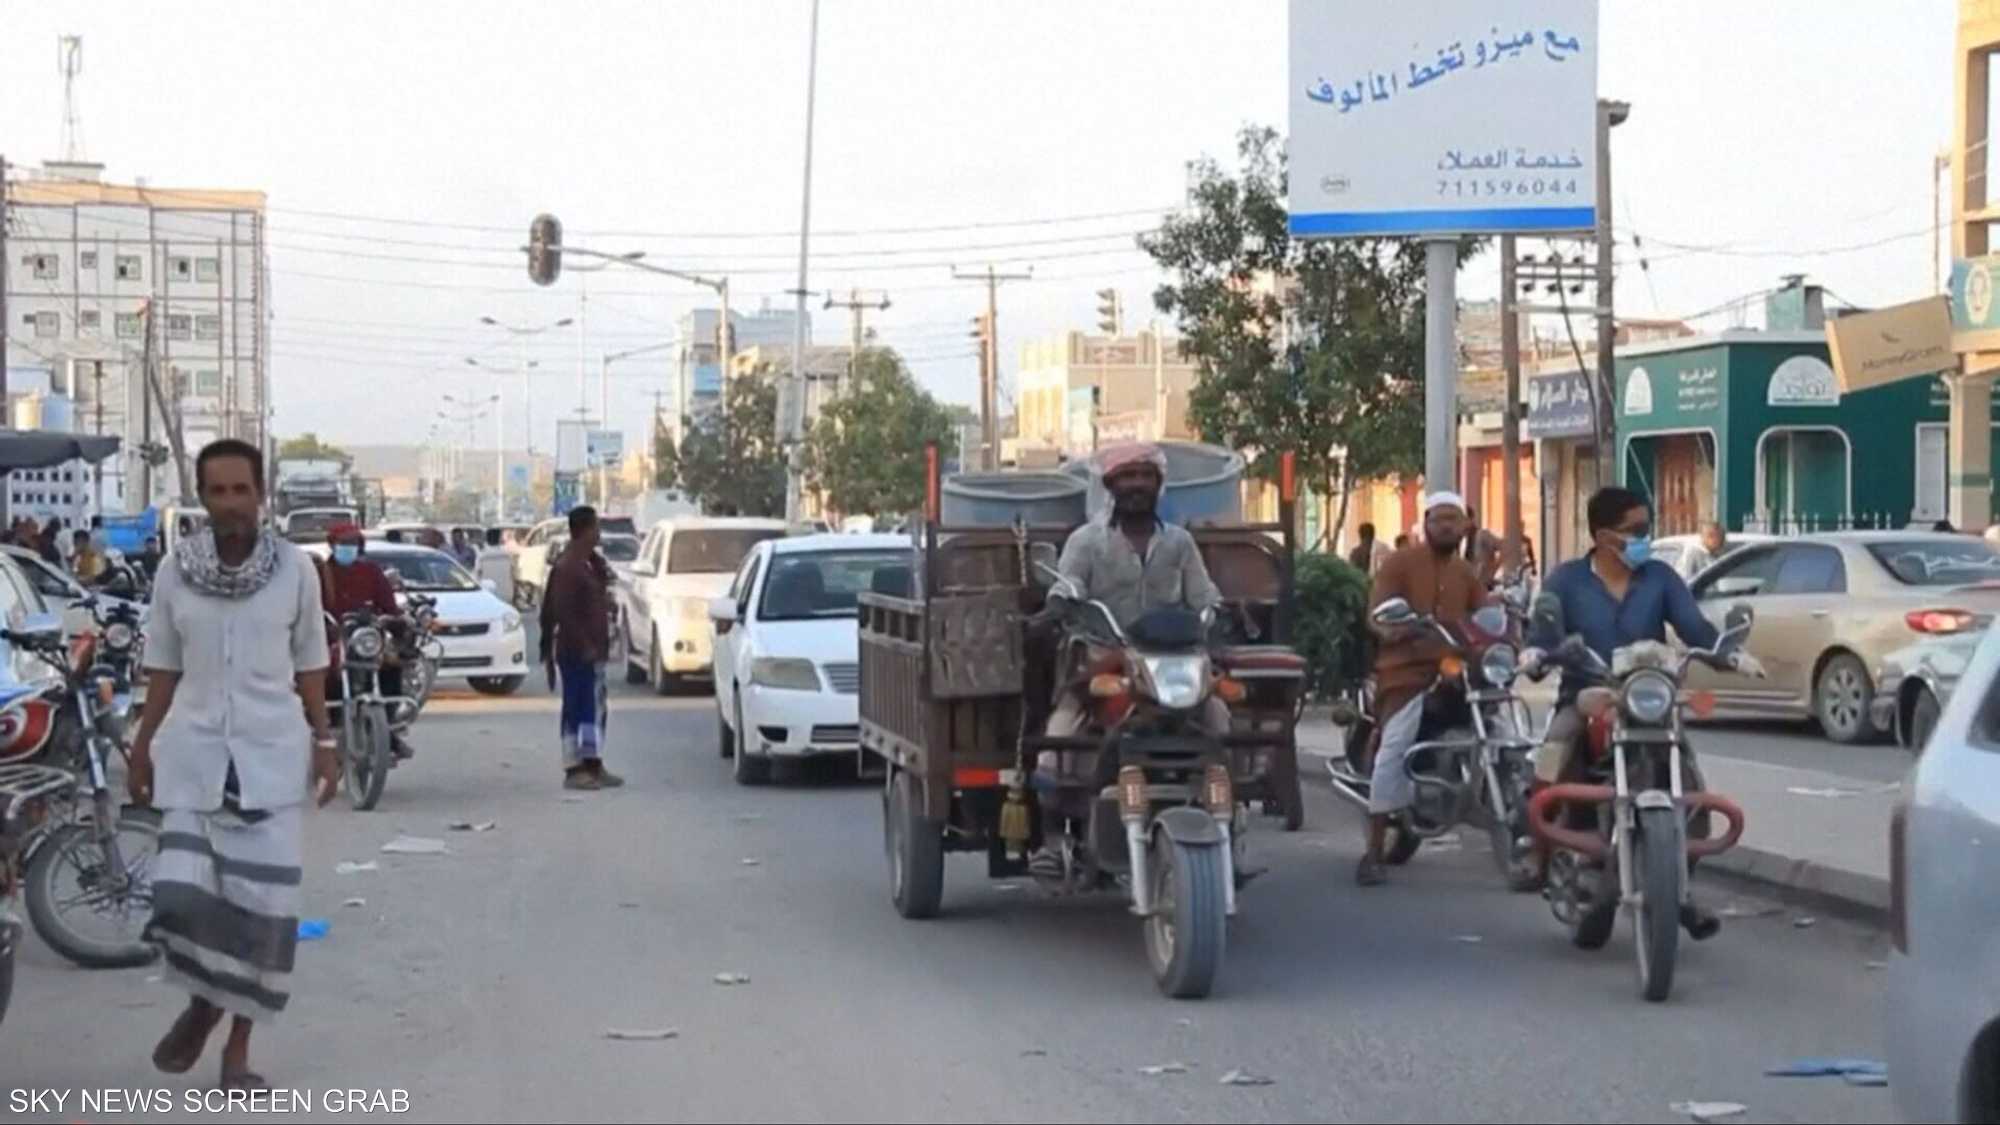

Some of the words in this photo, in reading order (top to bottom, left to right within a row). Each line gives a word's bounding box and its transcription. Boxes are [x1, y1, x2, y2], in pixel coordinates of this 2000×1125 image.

[1473, 26, 1534, 67] ميزو
[1545, 30, 1580, 61] مع
[1437, 150, 1508, 170] العملاء
[1515, 147, 1583, 169] خدمة
[1437, 179, 1577, 195] 711596044
